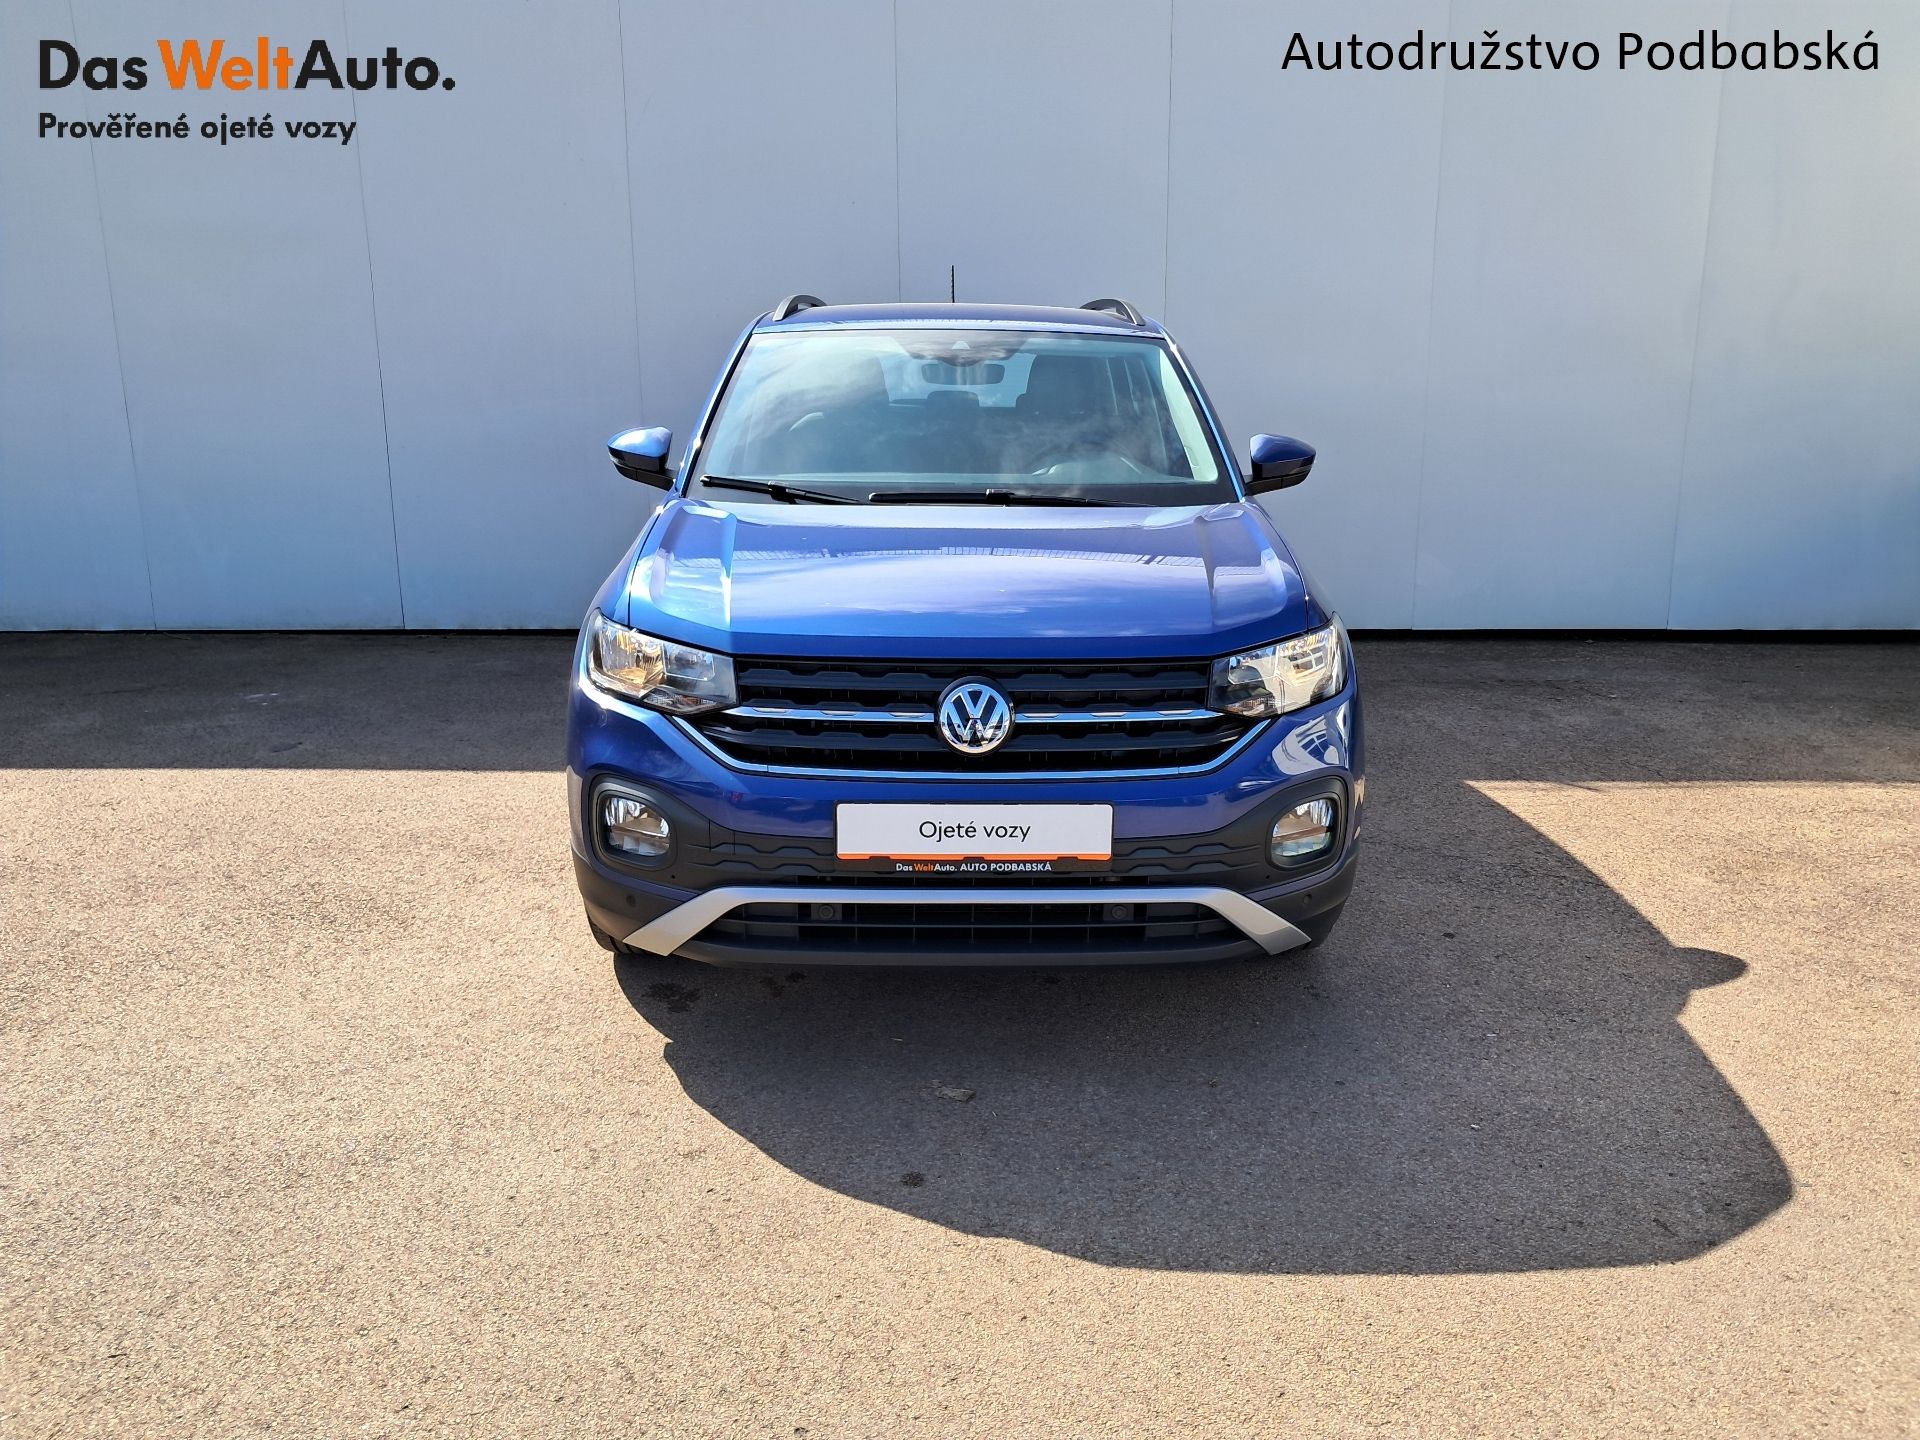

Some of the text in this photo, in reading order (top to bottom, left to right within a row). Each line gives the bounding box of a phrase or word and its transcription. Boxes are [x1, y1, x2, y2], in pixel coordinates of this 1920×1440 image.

[919, 821, 1031, 843] Ojeté vozy
[896, 863, 913, 872] Das
[960, 863, 988, 872] AUTO
[990, 861, 1052, 872] PODBABSKÁ
